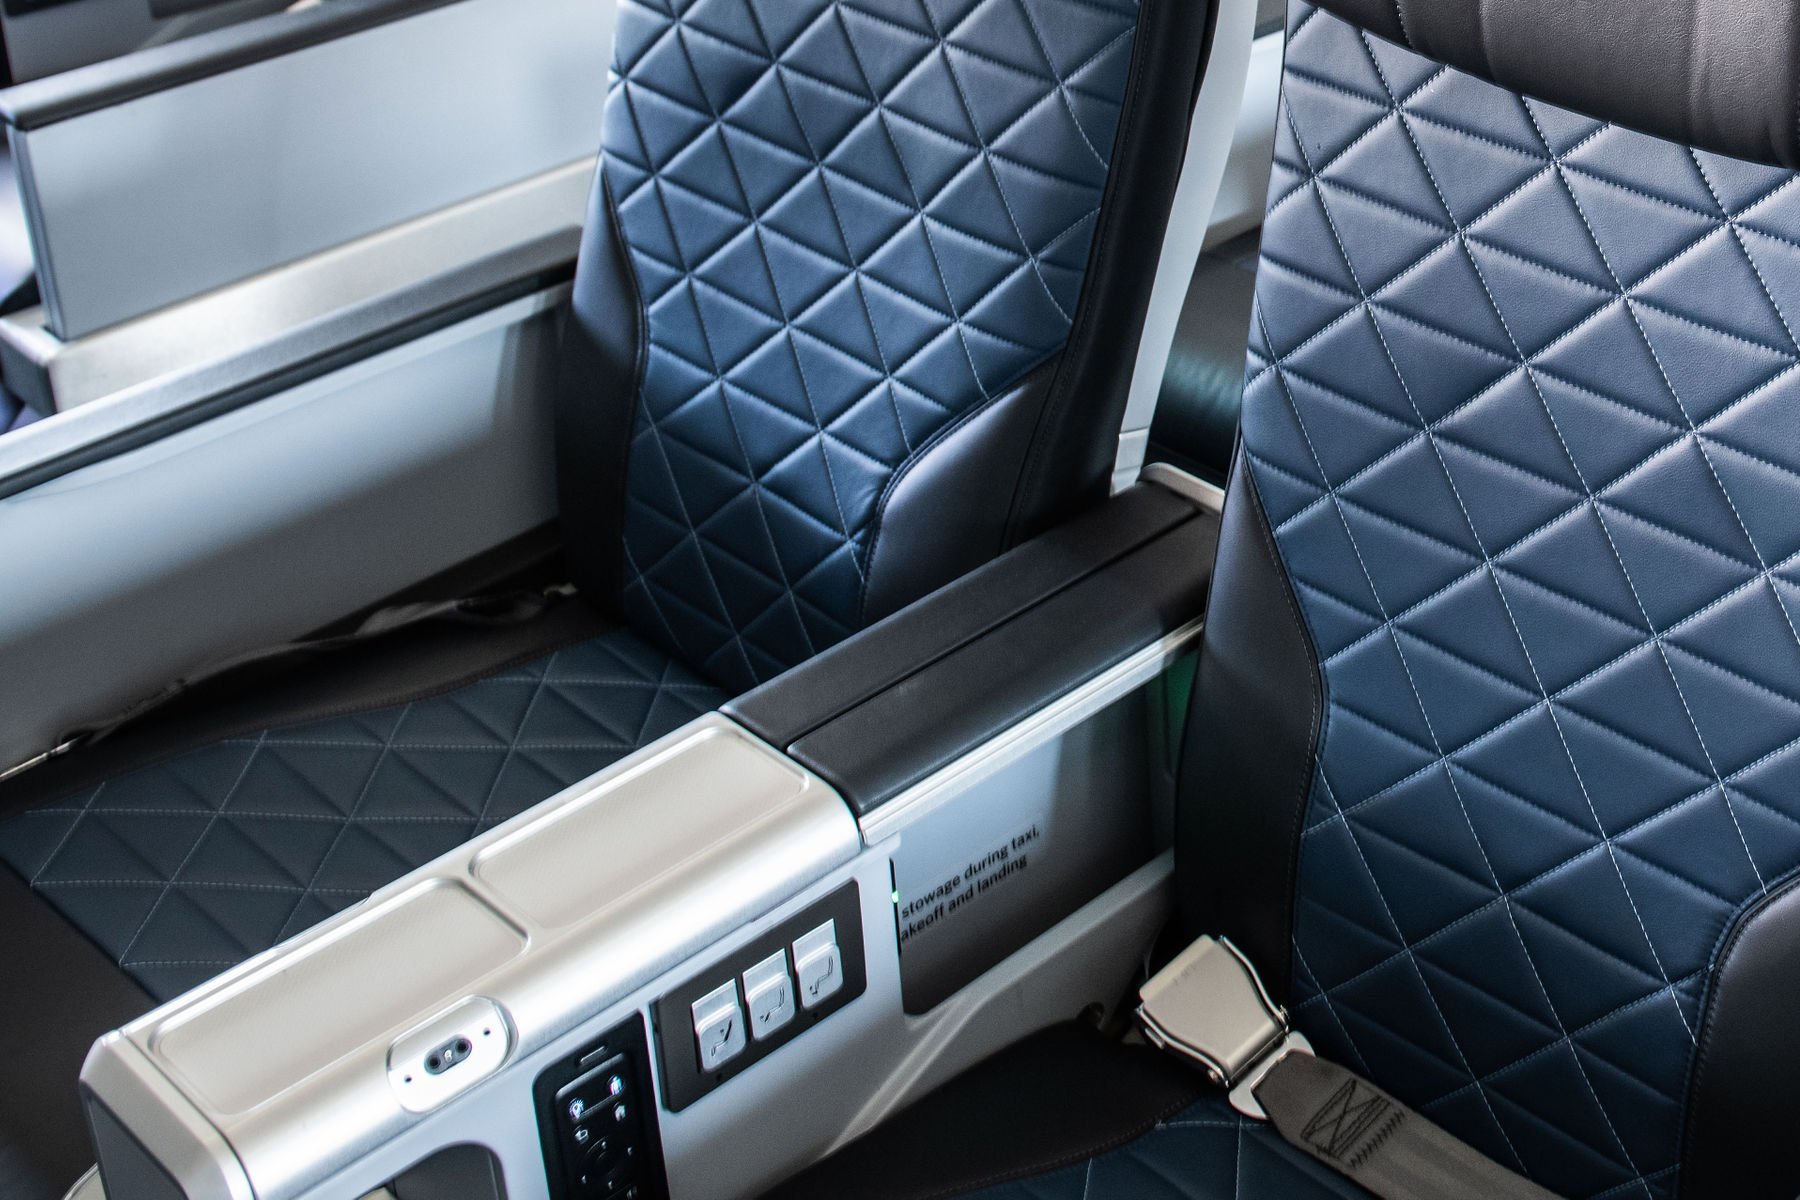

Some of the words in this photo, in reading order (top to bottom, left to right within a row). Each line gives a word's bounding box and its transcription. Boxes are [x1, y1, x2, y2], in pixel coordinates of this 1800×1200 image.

[900, 902, 944, 944] akeoff
[948, 884, 975, 914] and
[977, 854, 1029, 894] landing
[901, 874, 961, 919] stowage
[964, 845, 1009, 880] during
